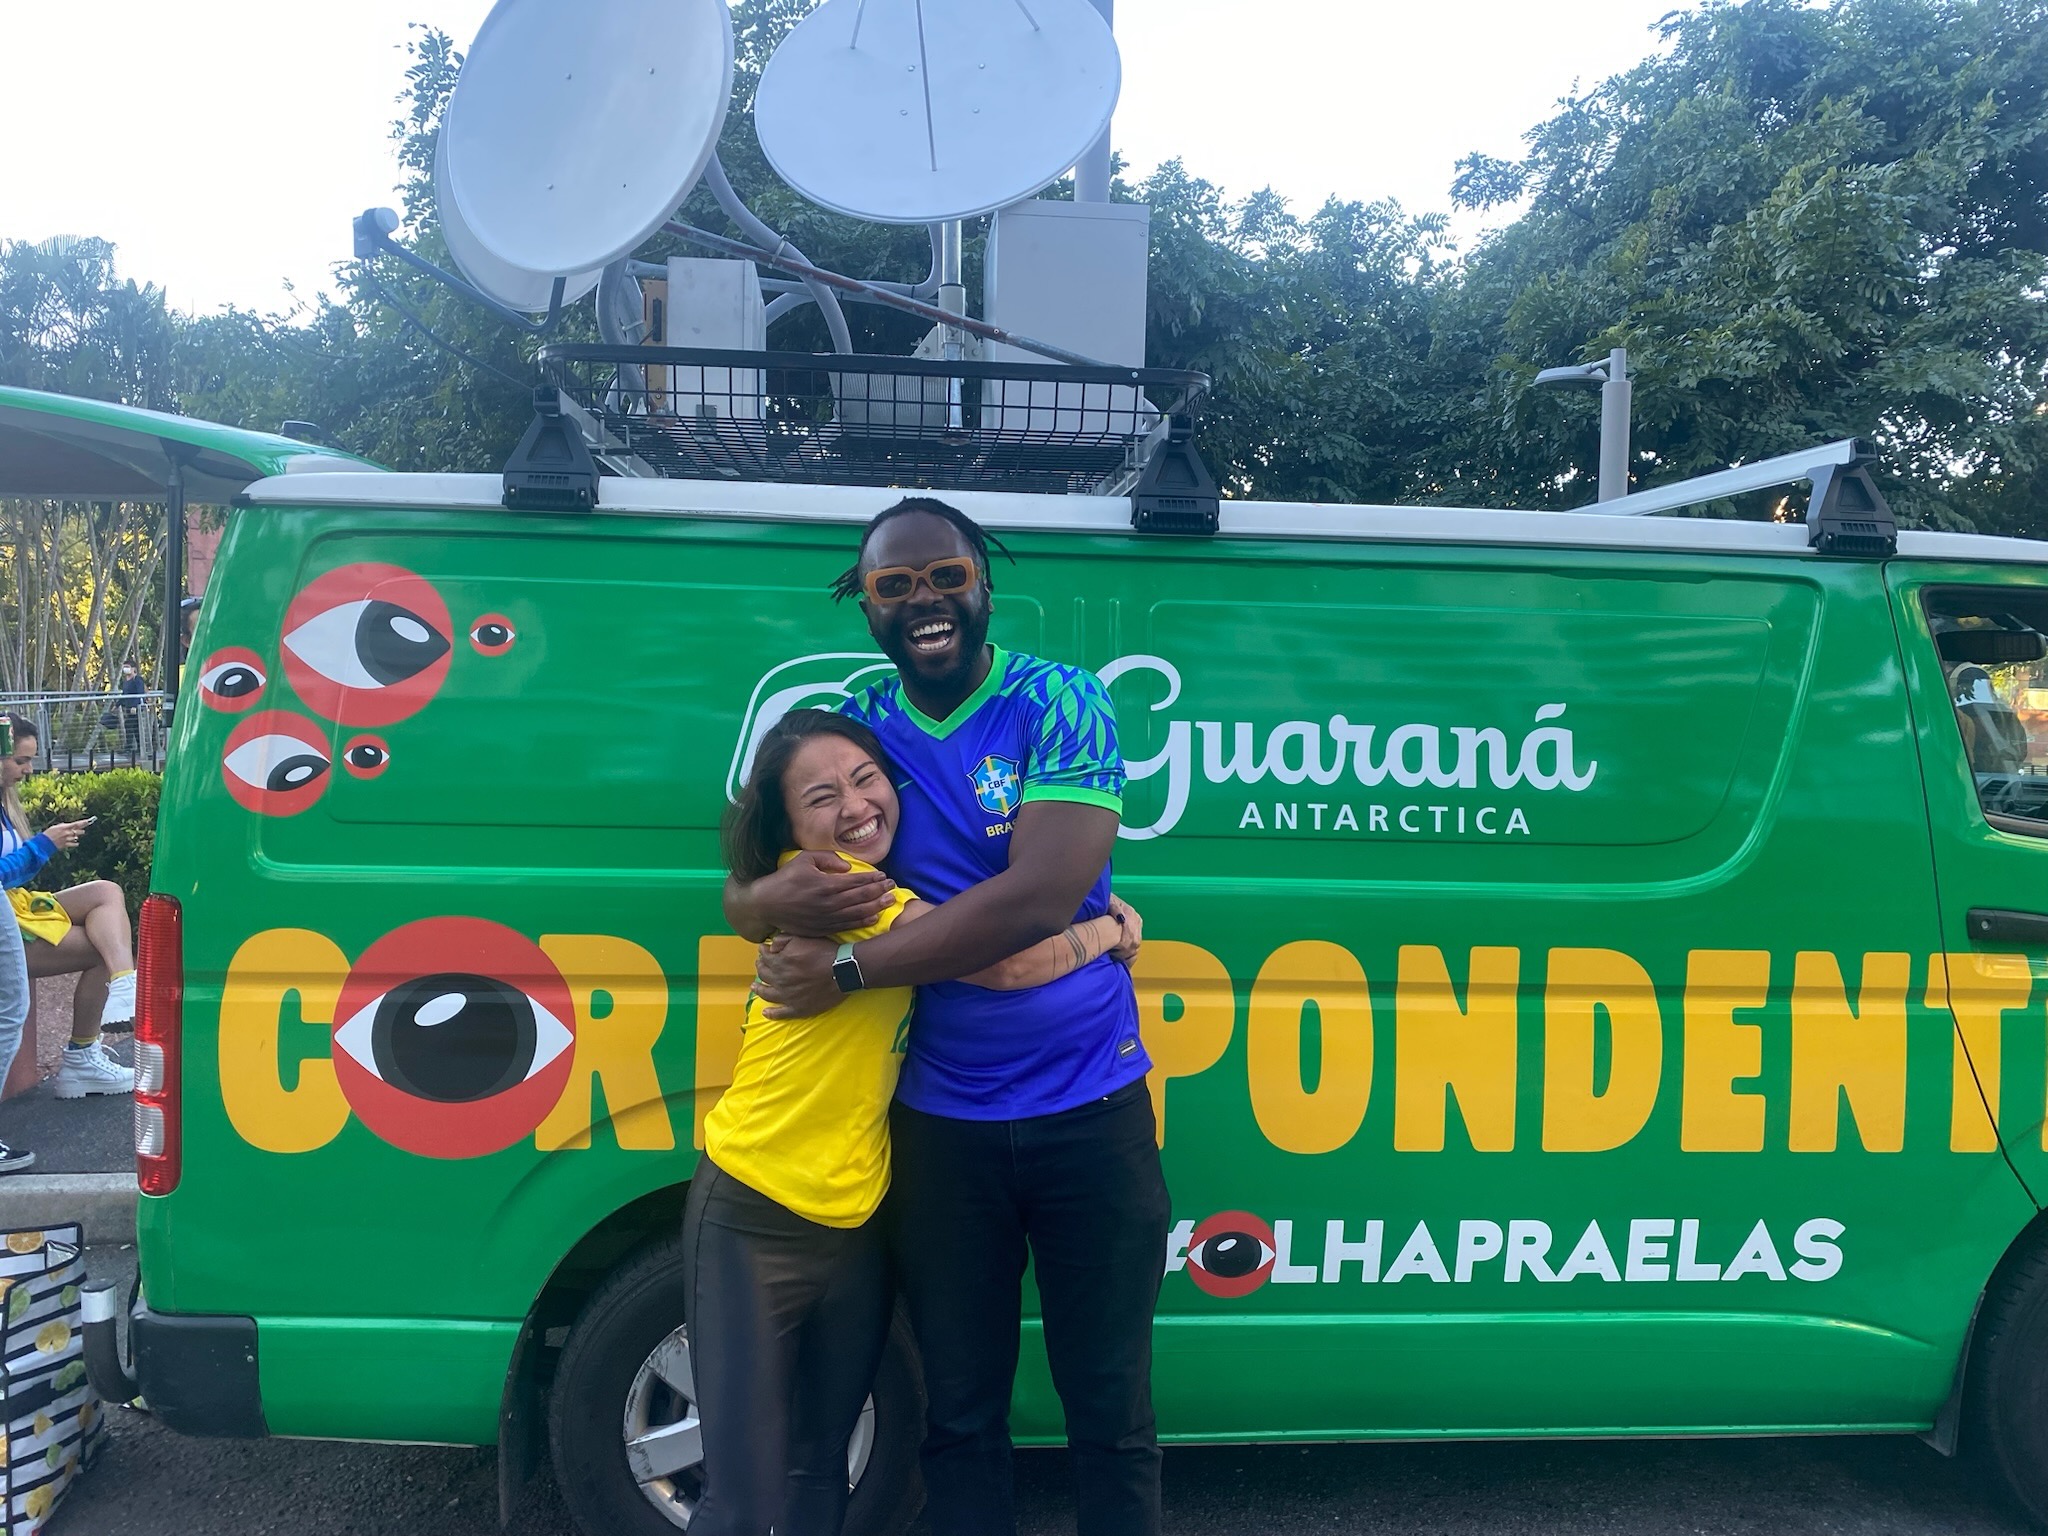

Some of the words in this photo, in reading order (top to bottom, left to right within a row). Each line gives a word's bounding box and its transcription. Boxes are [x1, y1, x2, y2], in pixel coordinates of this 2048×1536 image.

[1095, 653, 1598, 841] Guaraná
[988, 778, 1006, 790] CBF
[1238, 801, 1531, 835] ANTARCTICA
